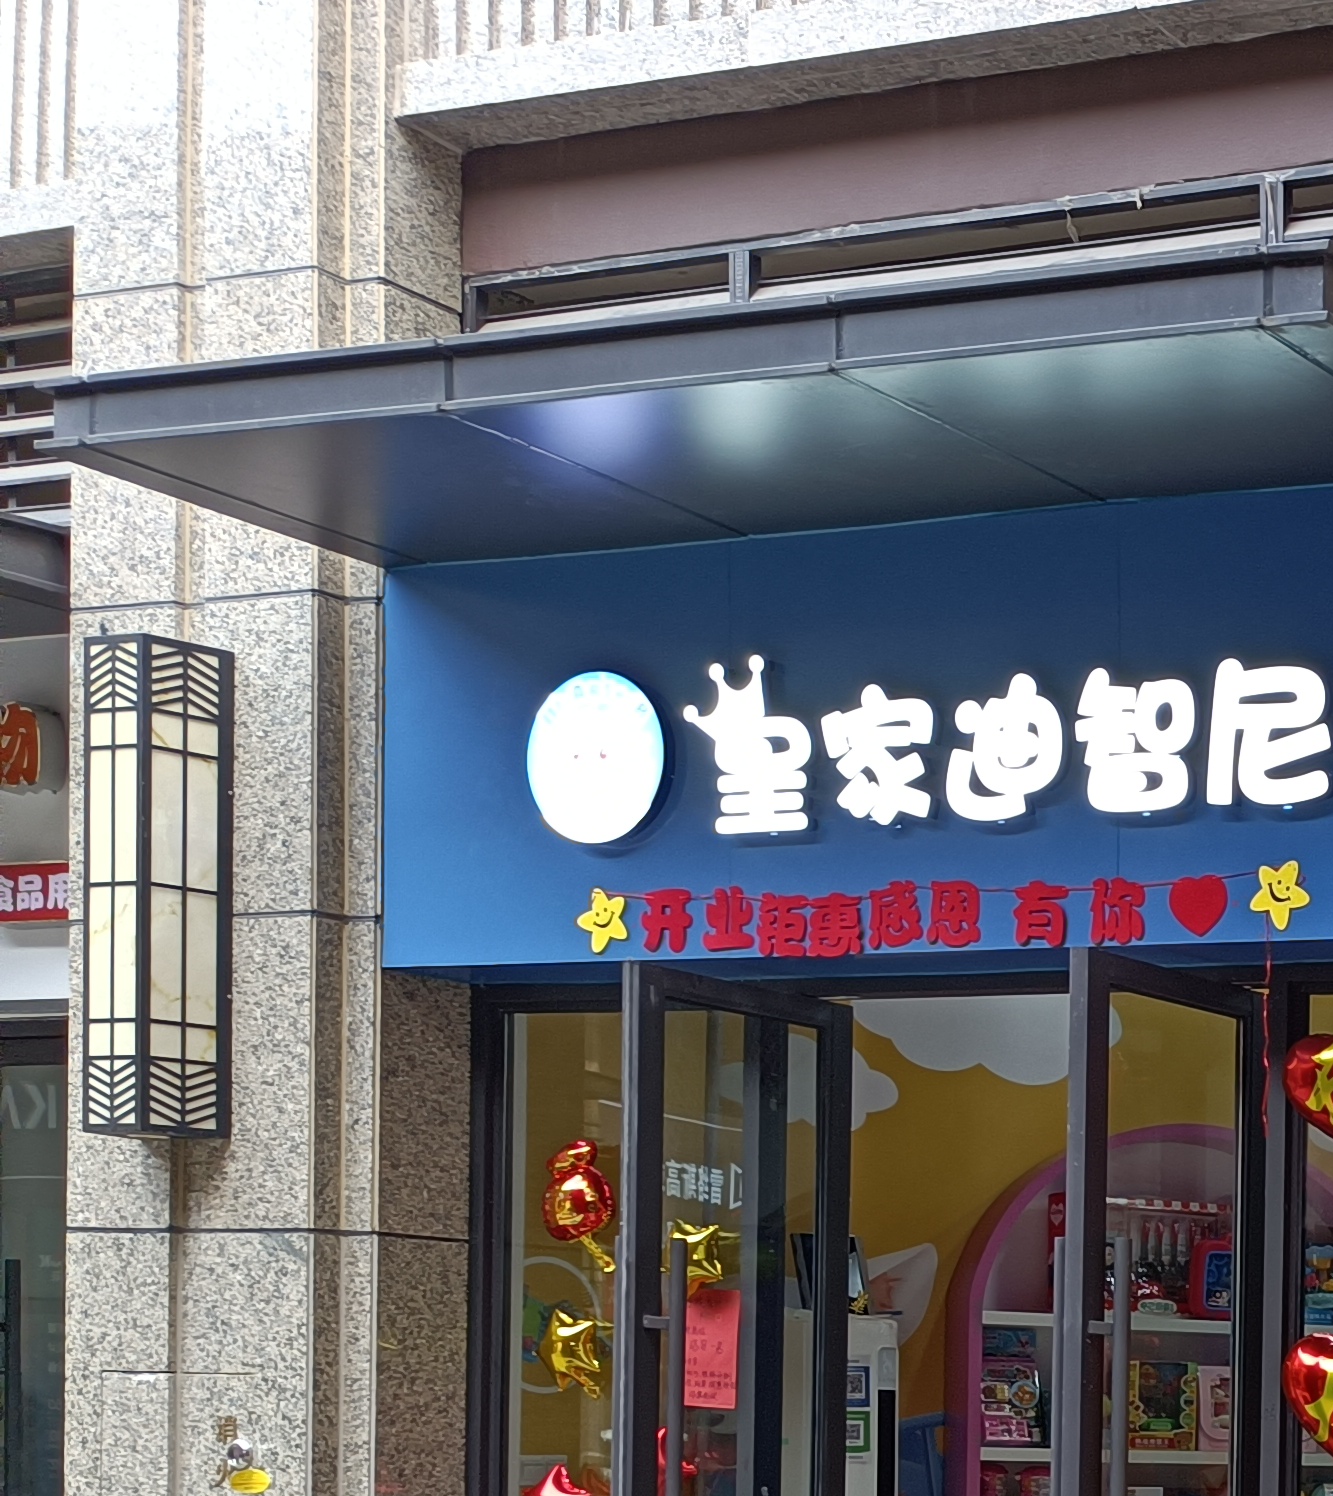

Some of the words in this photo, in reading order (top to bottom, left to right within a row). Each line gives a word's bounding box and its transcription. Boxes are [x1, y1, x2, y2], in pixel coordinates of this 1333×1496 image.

[684, 655, 1333, 836] 皇家迪智尼
